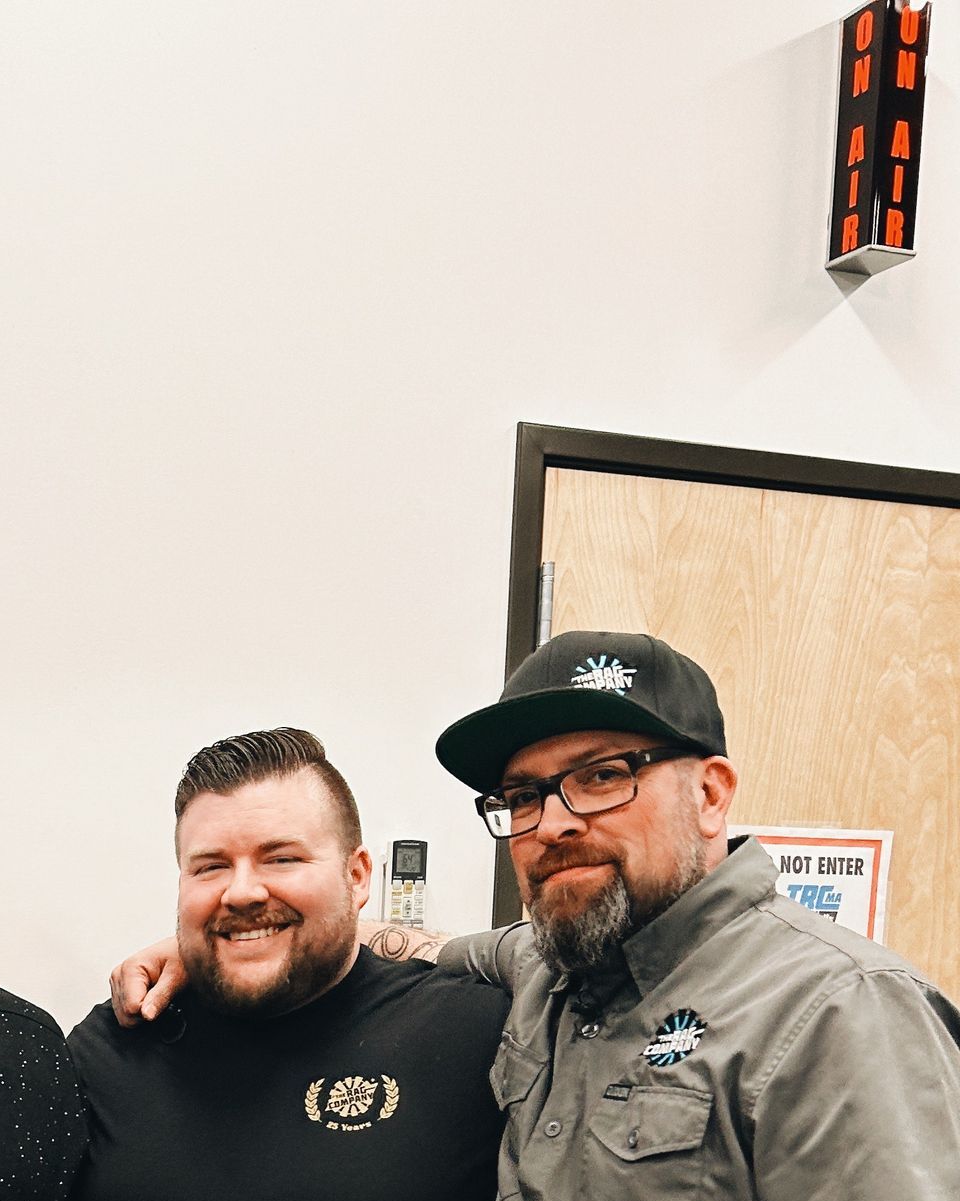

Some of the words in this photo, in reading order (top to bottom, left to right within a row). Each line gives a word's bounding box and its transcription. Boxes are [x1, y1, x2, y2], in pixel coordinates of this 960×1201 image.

[853, 10, 874, 98] ON
[842, 125, 865, 254] AIR
[885, 120, 910, 248] AIR
[780, 855, 812, 875] NOT
[818, 856, 864, 876] ENTER
[328, 1092, 375, 1109] COMPANY
[346, 1087, 368, 1098] RAG
[341, 1121, 372, 1132] Years
